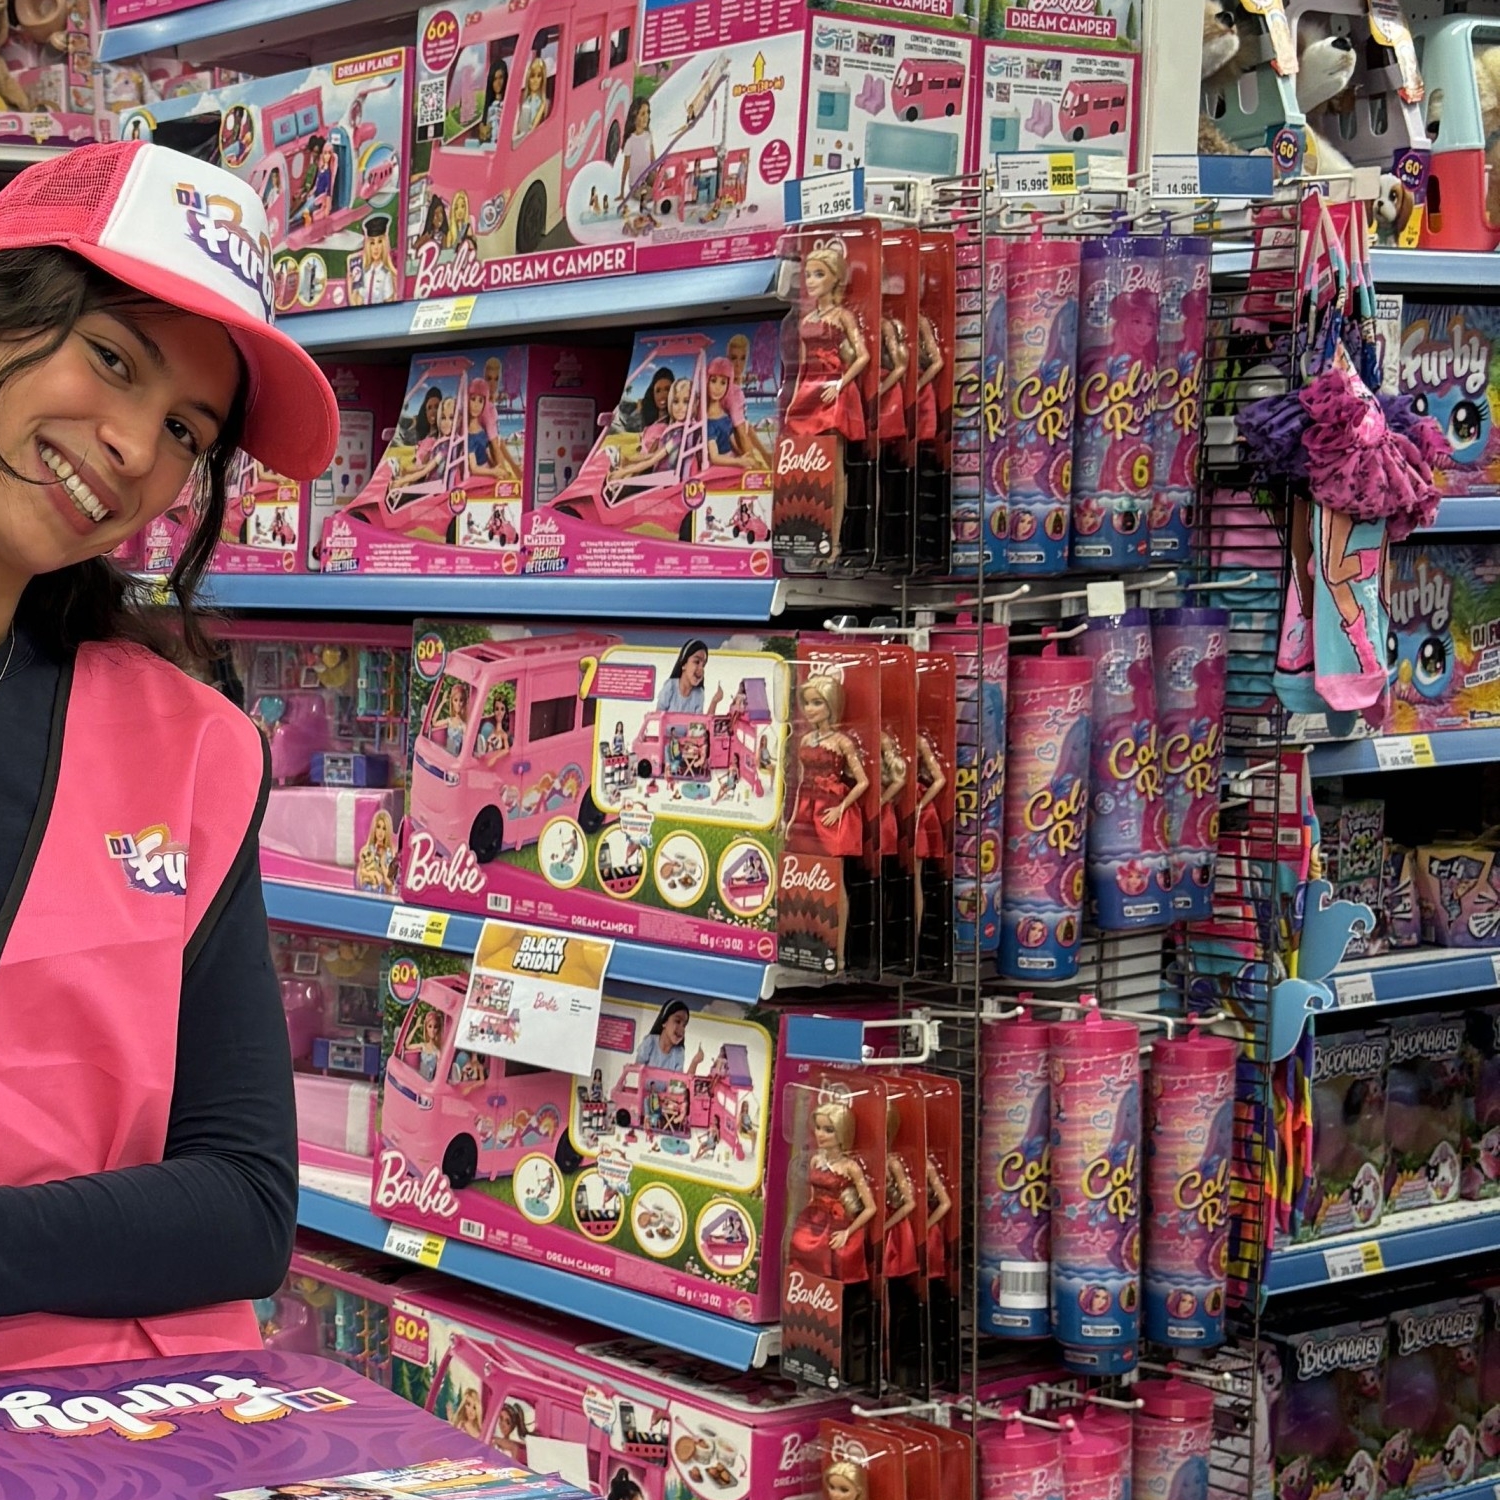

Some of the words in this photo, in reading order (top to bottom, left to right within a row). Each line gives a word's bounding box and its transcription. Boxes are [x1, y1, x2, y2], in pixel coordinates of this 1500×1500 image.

[427, 21, 456, 41] 60+
[1012, 12, 1056, 31] DREAM
[1059, 17, 1111, 36] CAMPER
[337, 62, 366, 79] DREAM
[366, 56, 395, 75] PLANE
[1052, 174, 1074, 187] PREIS
[176, 188, 202, 209] DJ
[195, 203, 273, 308] Furb
[416, 241, 486, 299] Barbie
[490, 258, 549, 285] DREAM
[553, 248, 627, 276] CAMPER
[1401, 324, 1489, 395] Furby
[1013, 364, 1076, 420] Colo
[777, 438, 831, 476] Barbie
[1132, 454, 1149, 488] 6
[524, 557, 567, 574] DETECTIVES
[531, 547, 560, 560] BEACH
[1390, 563, 1450, 631] urby
[417, 639, 444, 660] 60+
[1108, 724, 1159, 780] Col
[1024, 779, 1088, 833] Colo
[108, 837, 132, 856] DJ
[405, 833, 486, 894] Barbie
[781, 860, 836, 893] Barbie
[571, 914, 600, 930] DREAM
[600, 918, 636, 935] CAMPER
[519, 935, 567, 954] BLACK
[390, 966, 419, 984] 60+
[511, 952, 565, 974] FRIDAY
[379, 1151, 459, 1218] Barbie
[997, 1148, 1050, 1192] Col
[1081, 1146, 1136, 1199] Col
[1173, 1158, 1228, 1210] Col
[546, 1250, 576, 1269] DREAM
[576, 1256, 613, 1278] CAMPER
[786, 1270, 839, 1313] Barbie
[394, 1315, 429, 1342] 60+
[1400, 1310, 1478, 1350] BLOOMABLES
[1301, 1334, 1383, 1374] BLOOMABLES
